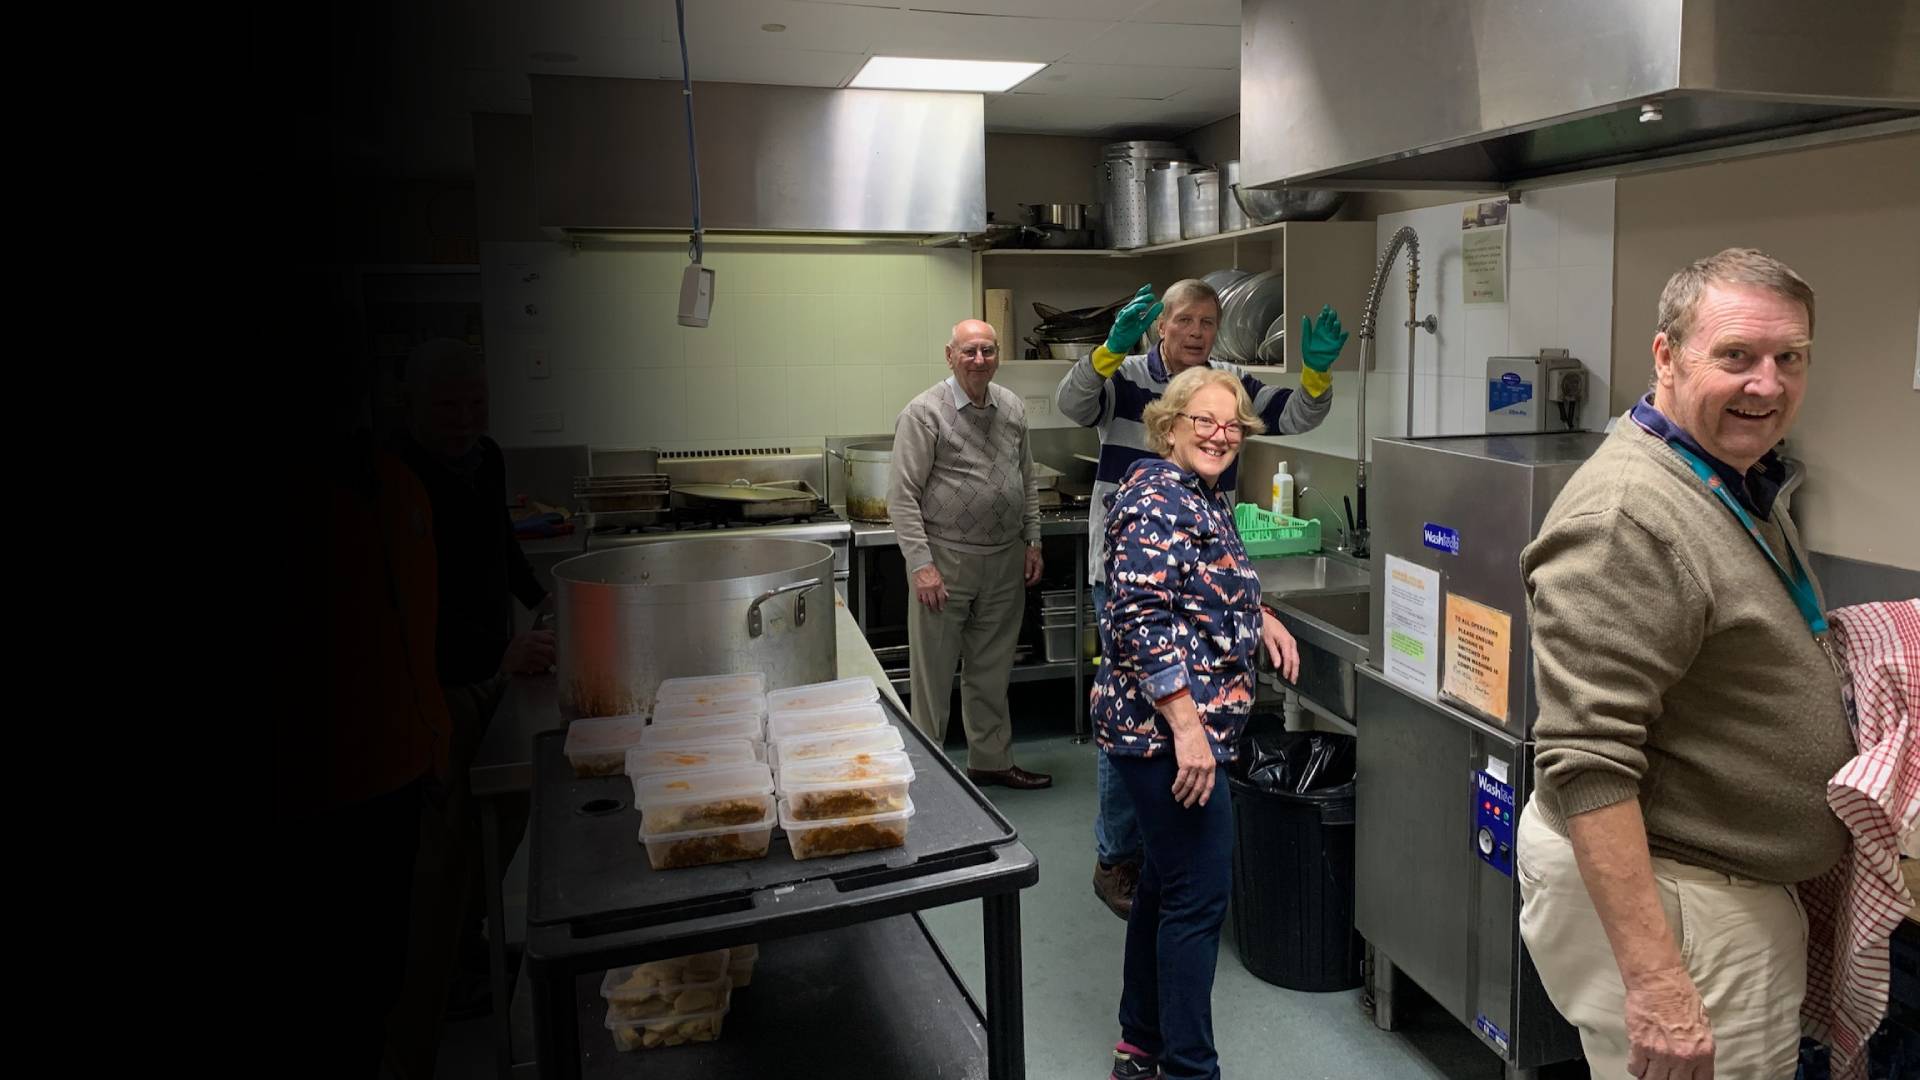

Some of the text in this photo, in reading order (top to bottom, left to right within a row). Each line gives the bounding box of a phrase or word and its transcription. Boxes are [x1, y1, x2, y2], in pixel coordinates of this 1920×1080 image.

[1458, 627, 1494, 647] PLEASE ENSURE
[1471, 622, 1498, 637] OPERATORS
[1458, 636, 1478, 648] MACHINE
[1458, 644, 1490, 662] SWITCHED OFF
[1457, 661, 1484, 677] COMPLETED
[1458, 652, 1471, 663] WHEN
[1471, 658, 1492, 673] WASHING
